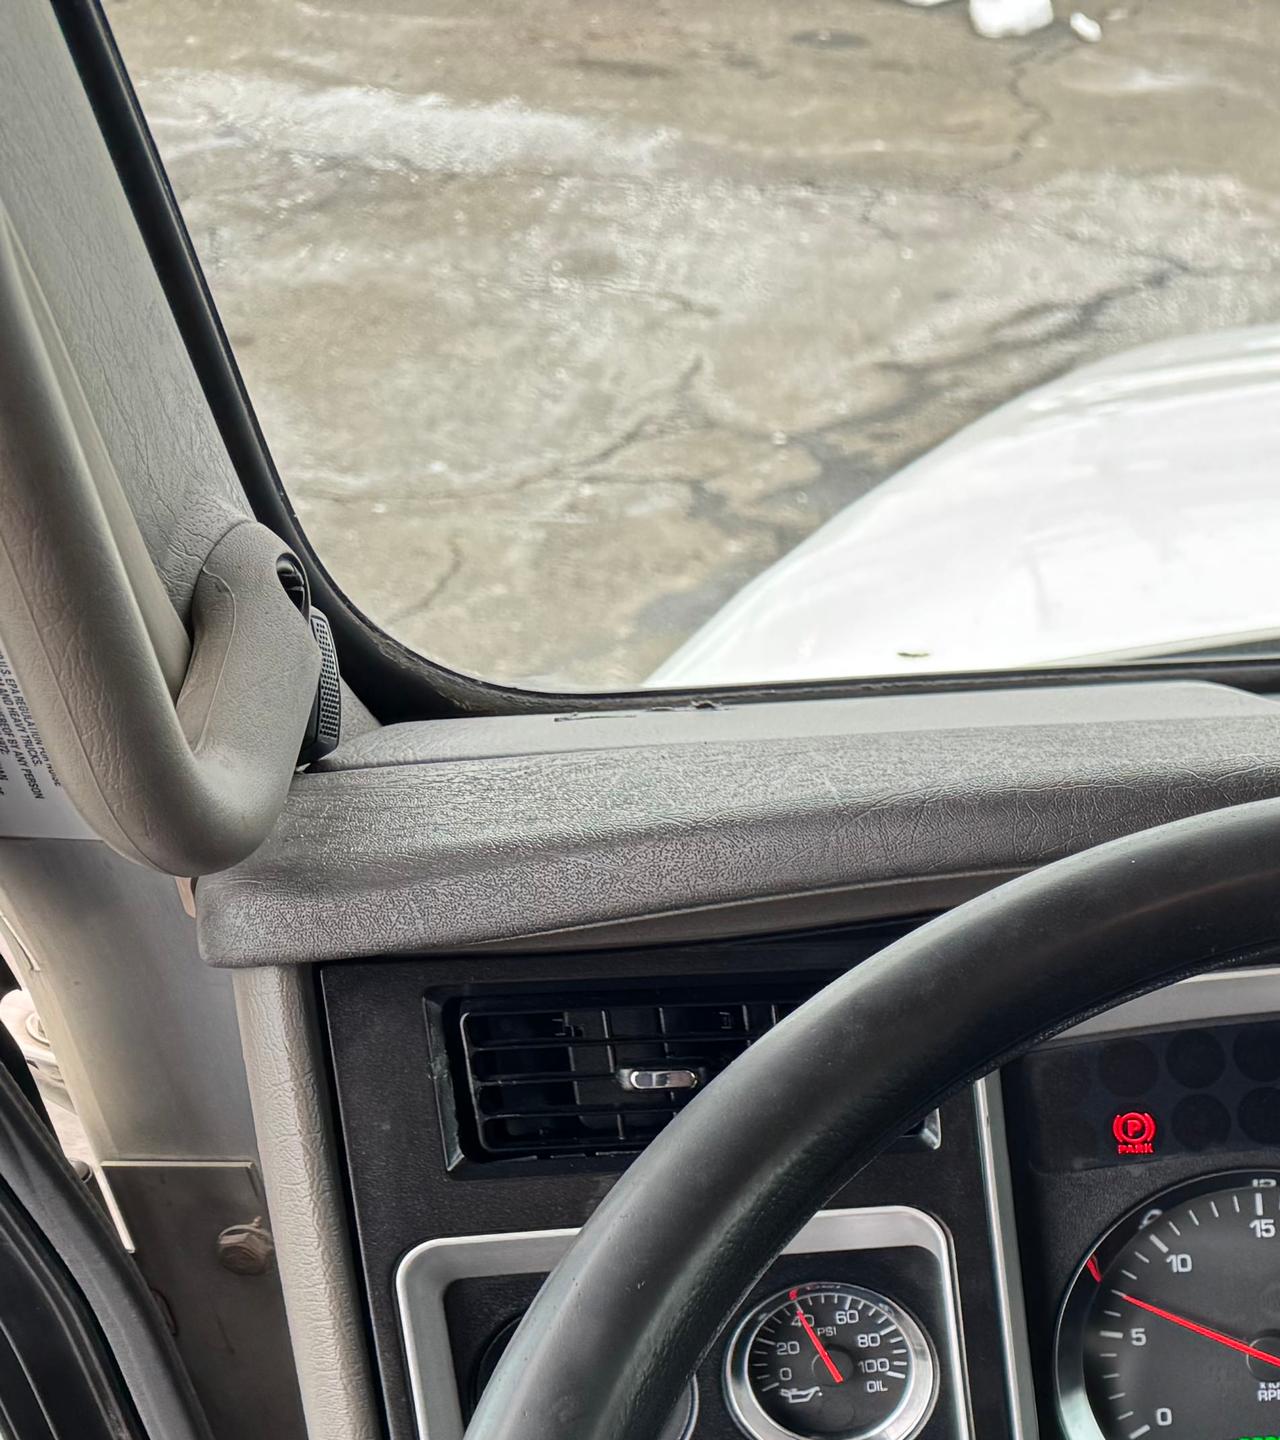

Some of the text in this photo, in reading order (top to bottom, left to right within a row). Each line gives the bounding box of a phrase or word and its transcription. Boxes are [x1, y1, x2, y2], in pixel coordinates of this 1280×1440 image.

[5, 678, 20, 694] EPA
[7, 707, 27, 733] HEAVY
[13, 750, 29, 767] ANY
[20, 768, 45, 799] PERSON
[1249, 1218, 1276, 1239] 15
[1166, 1253, 1193, 1273] 10
[835, 1309, 859, 1325] 60
[817, 1326, 837, 1337] PSI
[1131, 1328, 1147, 1347] 5
[776, 1340, 800, 1355] 20
[857, 1333, 881, 1348] 80
[858, 1358, 890, 1373] 100
[779, 1367, 792, 1381] 0
[866, 1380, 889, 1393] OIL
[1156, 1407, 1173, 1427] 0
